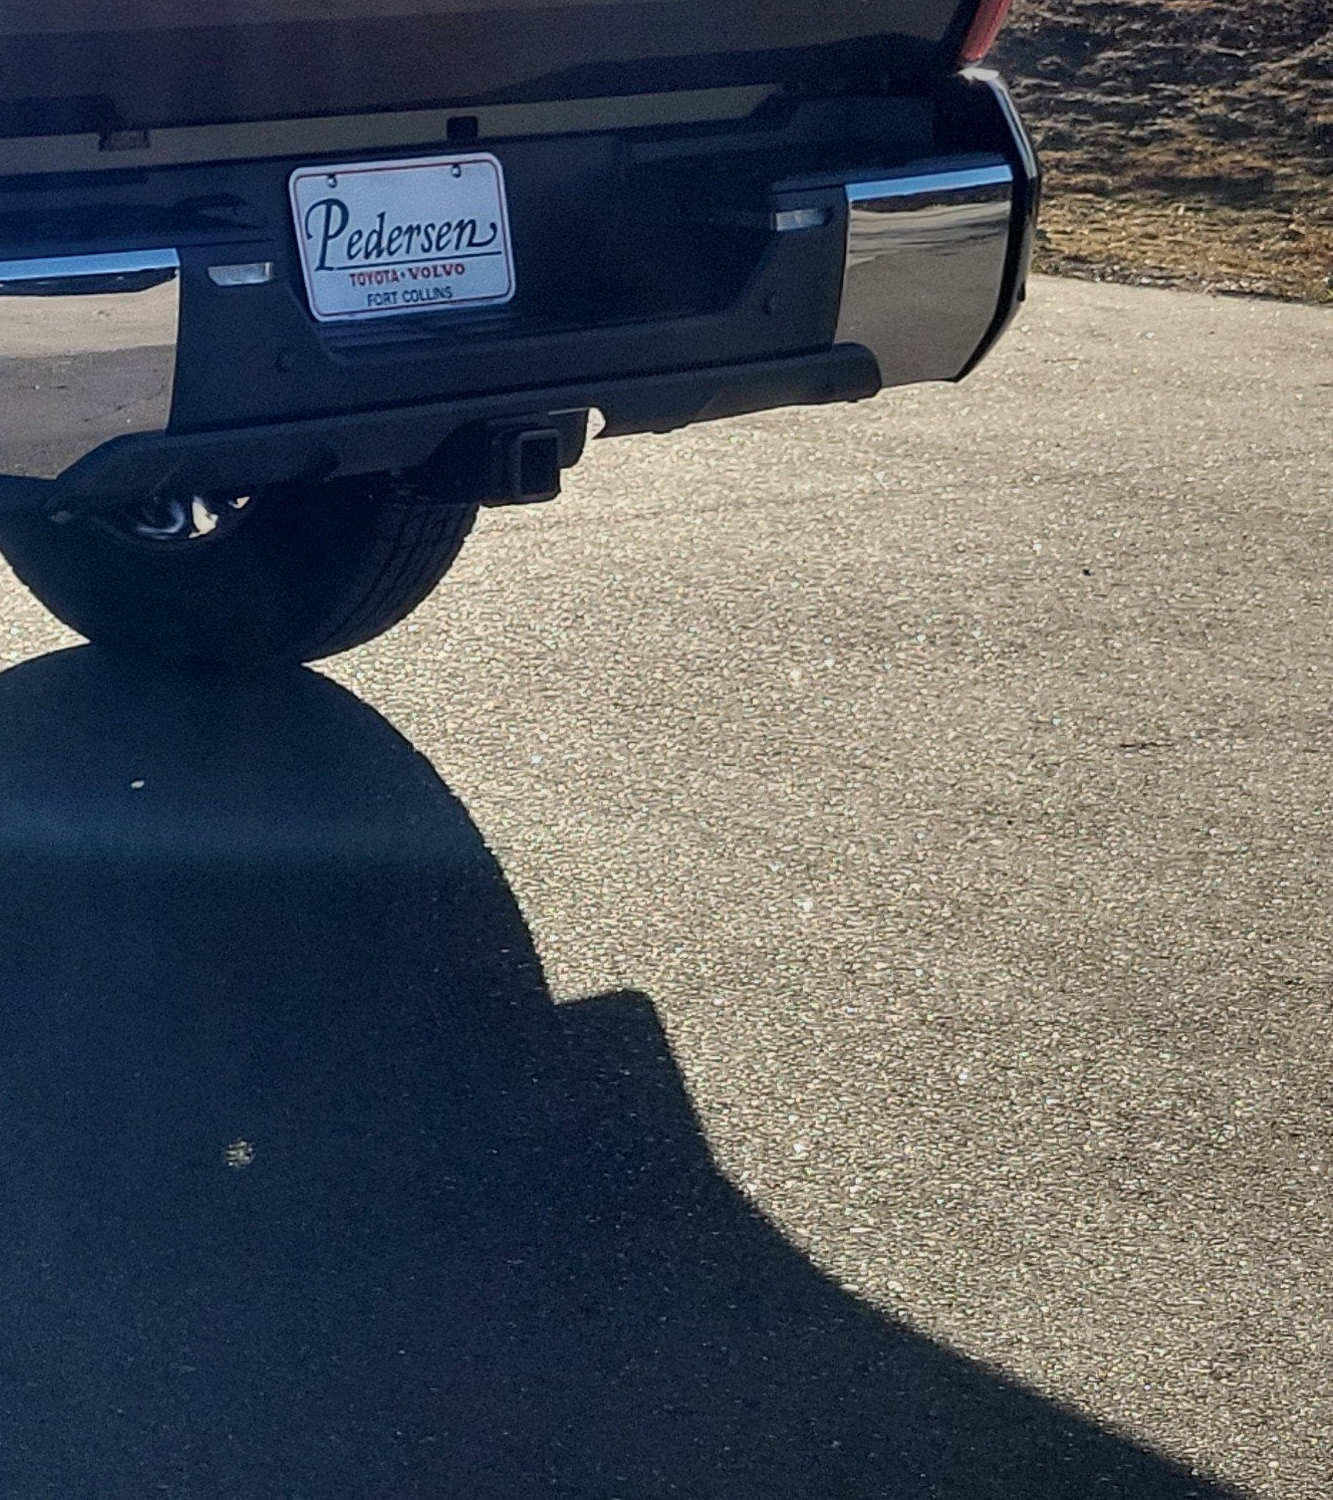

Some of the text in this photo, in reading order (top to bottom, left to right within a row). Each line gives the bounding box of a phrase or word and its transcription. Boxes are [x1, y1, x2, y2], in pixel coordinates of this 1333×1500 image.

[304, 198, 498, 271] Pedersen
[349, 264, 465, 287] TOYOTA VOLVO
[367, 286, 453, 307] FORT COLLINS
